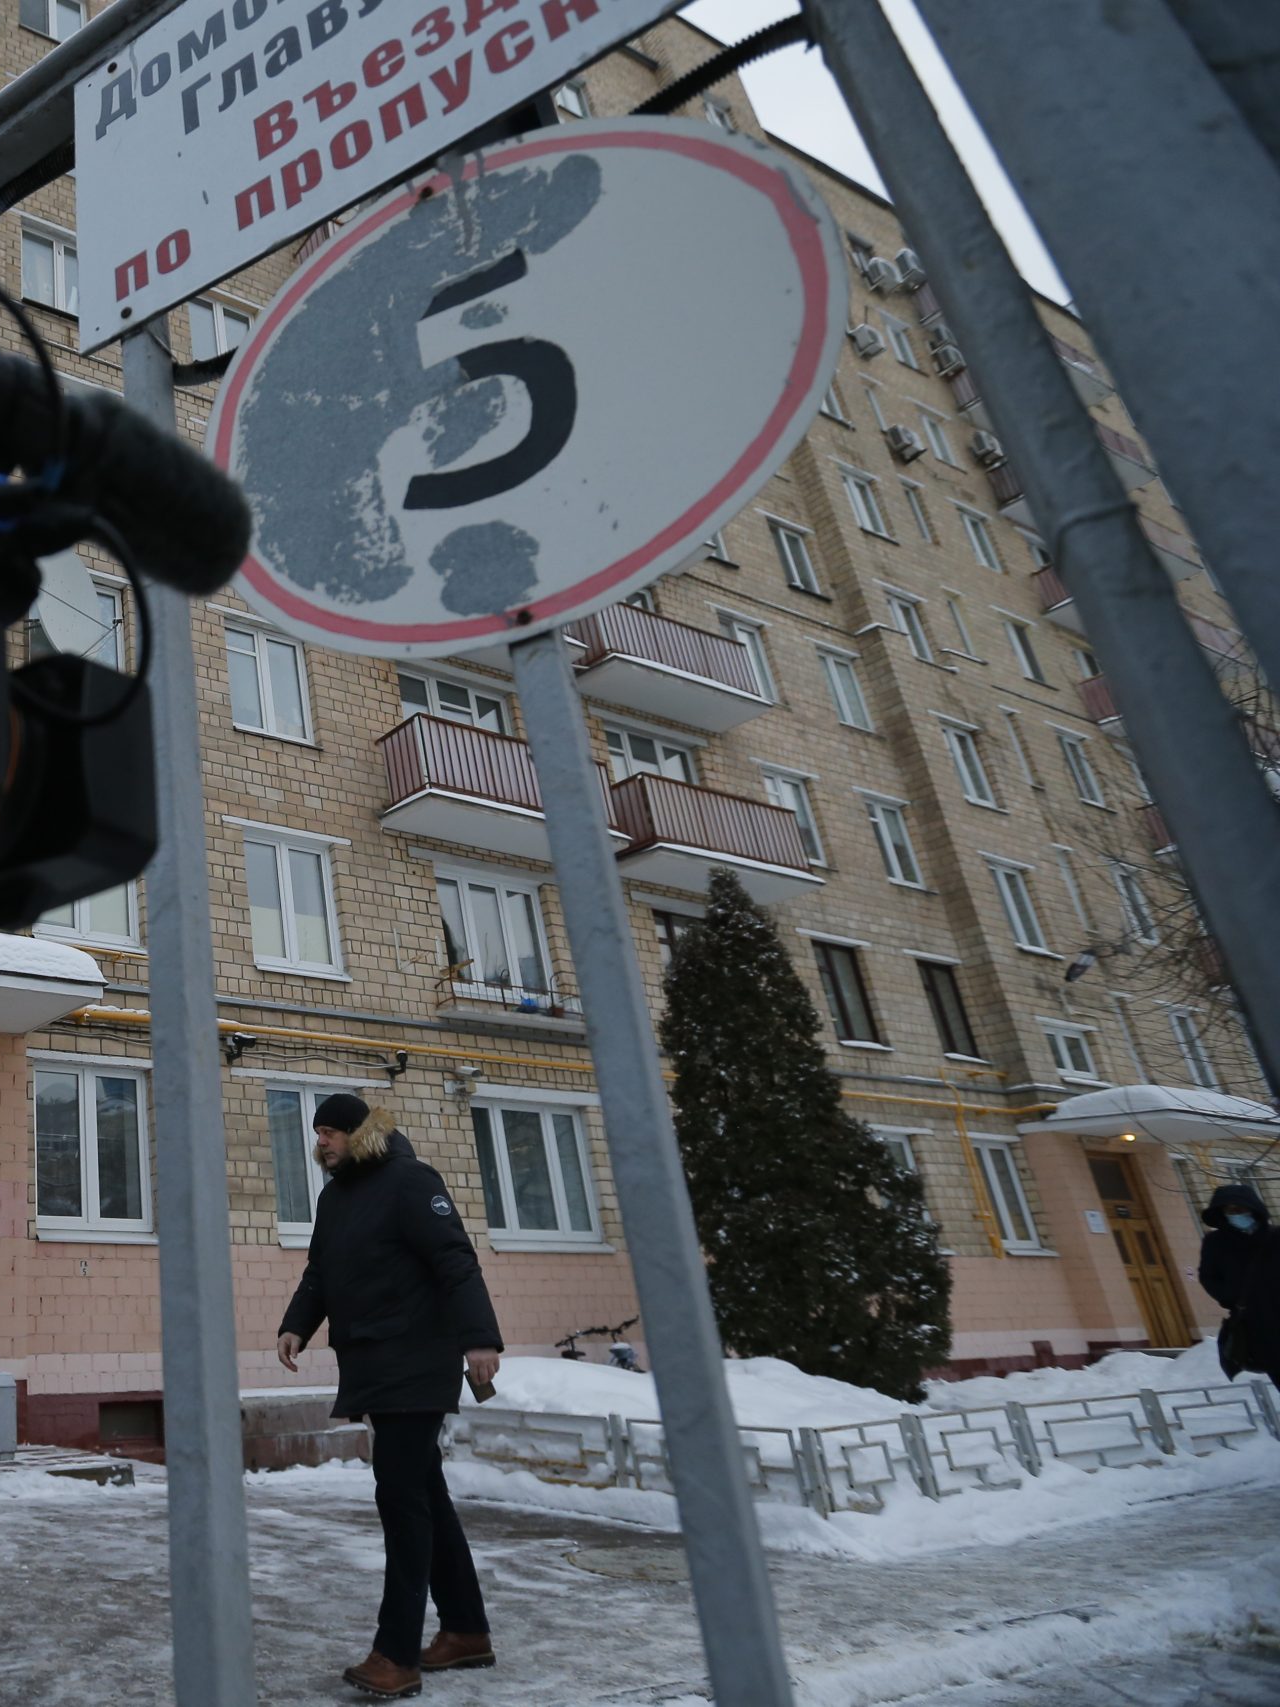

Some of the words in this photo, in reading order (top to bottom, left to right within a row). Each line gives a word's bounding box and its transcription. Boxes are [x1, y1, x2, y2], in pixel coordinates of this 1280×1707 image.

[96, 0, 283, 141] Домо
[114, 228, 191, 302] по
[403, 248, 577, 511] 5
